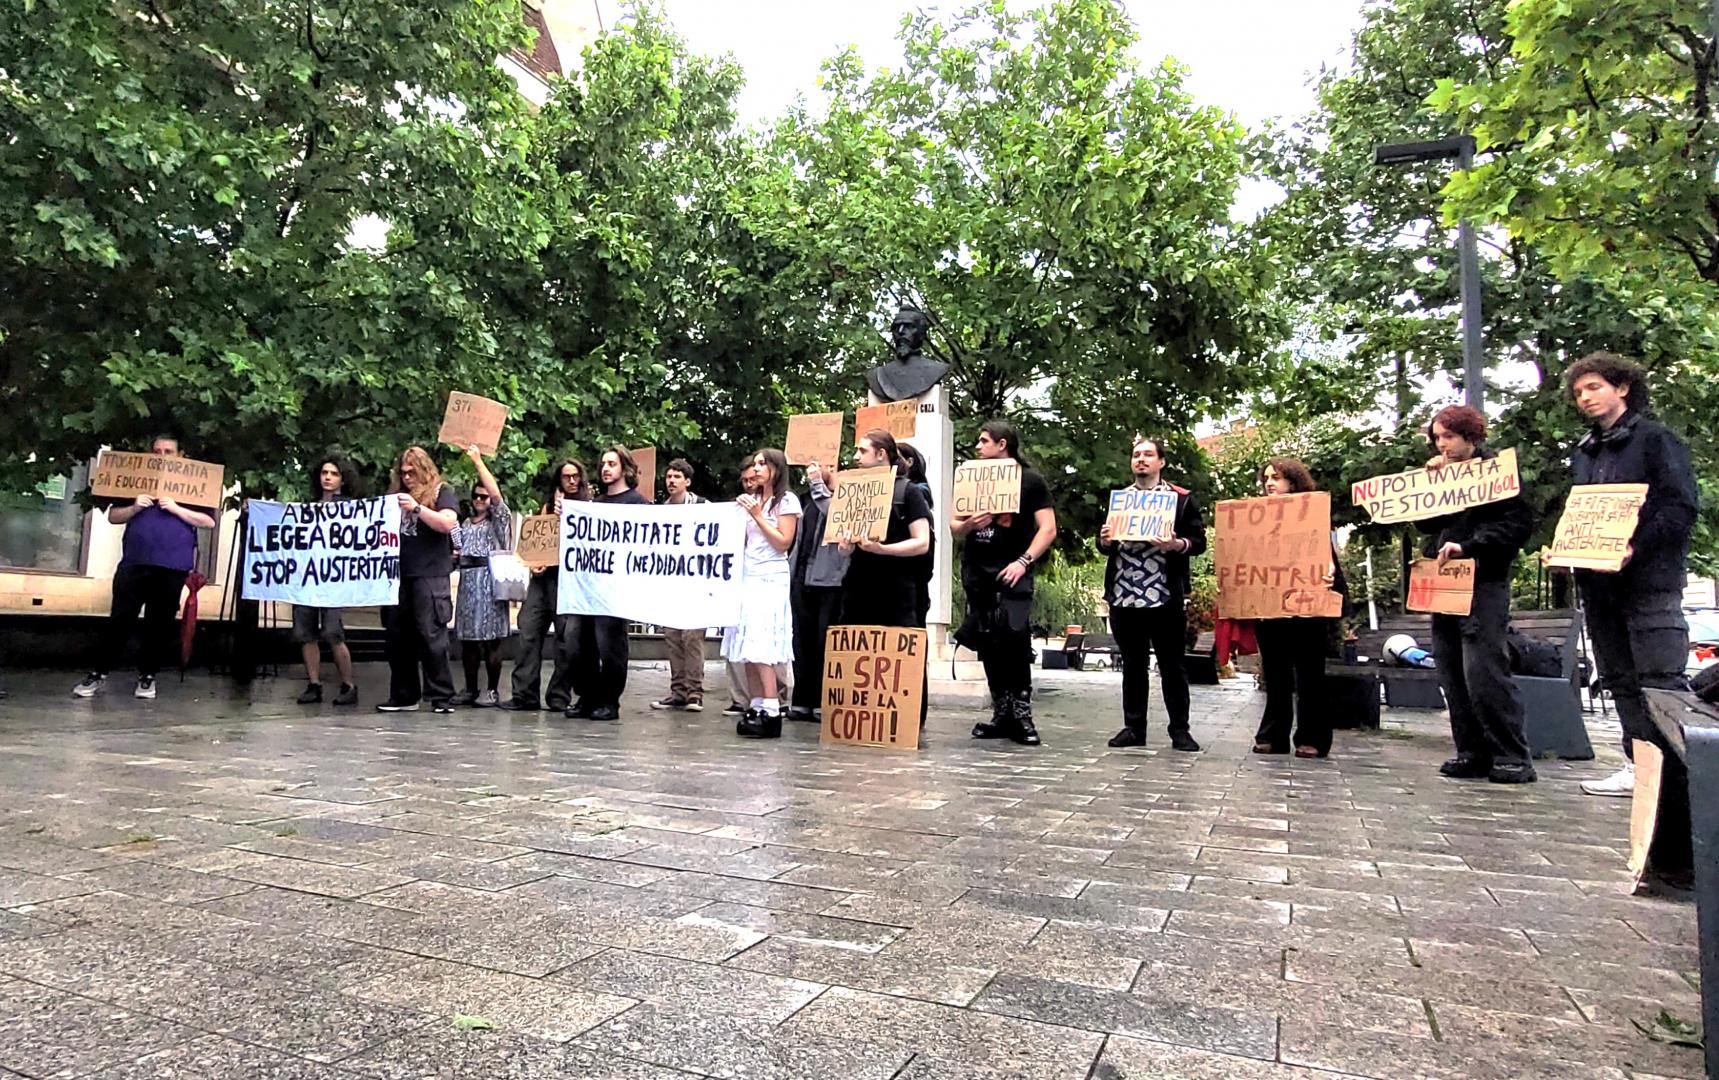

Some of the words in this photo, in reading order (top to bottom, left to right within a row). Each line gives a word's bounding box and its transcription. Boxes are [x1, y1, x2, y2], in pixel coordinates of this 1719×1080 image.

[975, 481, 996, 497] NU
[1353, 478, 1379, 504] NU
[1382, 471, 1422, 496] POT
[1370, 499, 1395, 518] PE
[1400, 481, 1498, 514] STOMACUL
[1494, 473, 1519, 495] GOL
[832, 506, 887, 524] GUVERNUL
[249, 524, 326, 552] LEGEA
[566, 514, 682, 546] SOLIDARITATE
[693, 522, 720, 547] CU
[250, 557, 298, 587] STOP
[565, 547, 615, 575] CADRELE
[1219, 563, 1326, 588] PENTRU
[897, 633, 918, 656] DE
[827, 661, 843, 679] LA
[828, 688, 845, 706] NU
[852, 690, 869, 706] DE
[877, 693, 897, 709] LA
